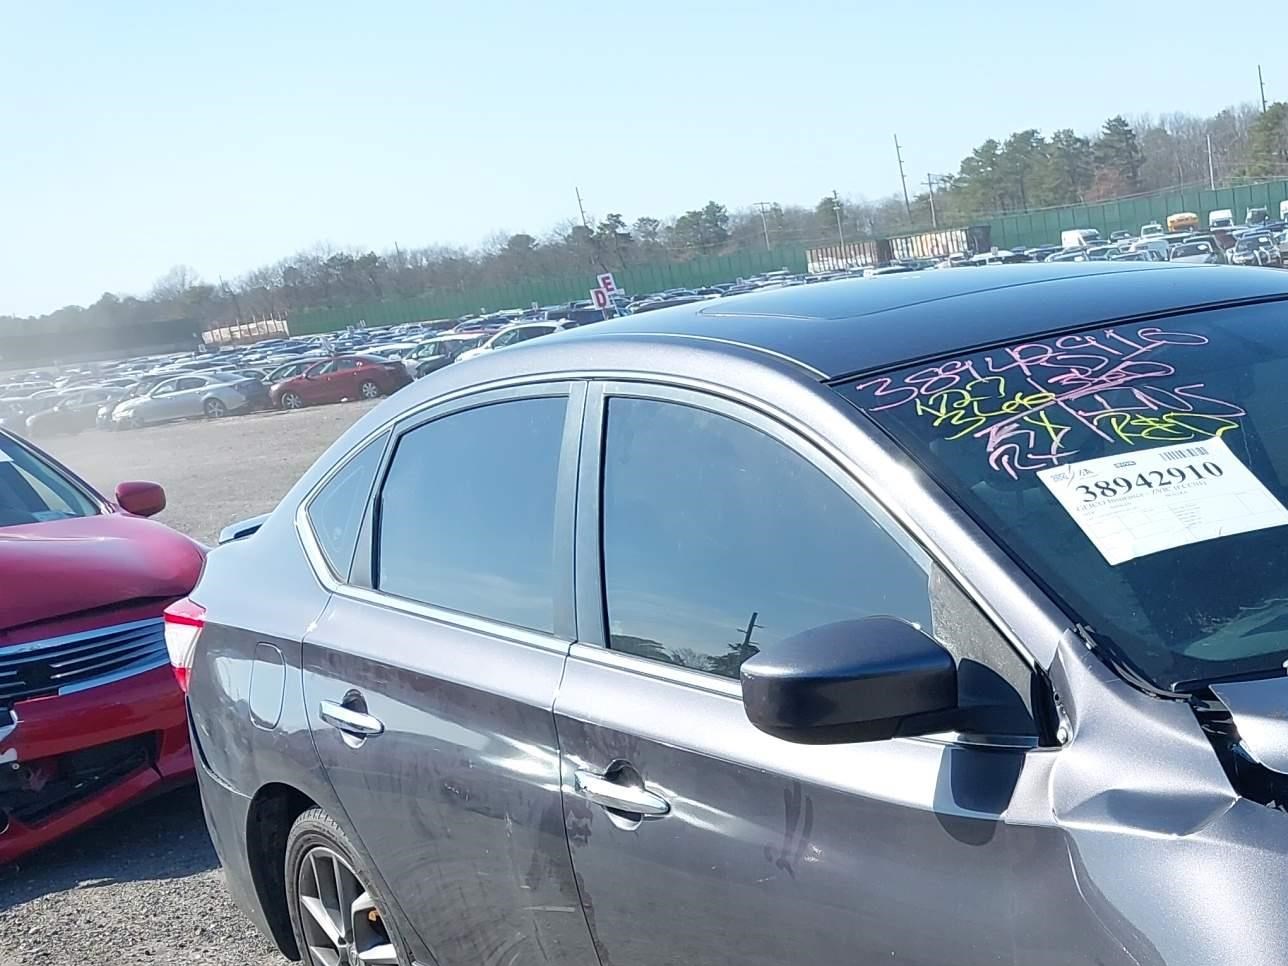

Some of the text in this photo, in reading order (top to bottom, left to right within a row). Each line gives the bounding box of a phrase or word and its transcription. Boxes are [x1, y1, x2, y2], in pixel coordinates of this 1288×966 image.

[601, 276, 614, 292] E
[594, 290, 606, 308] D
[1075, 461, 1224, 502] 38942910
